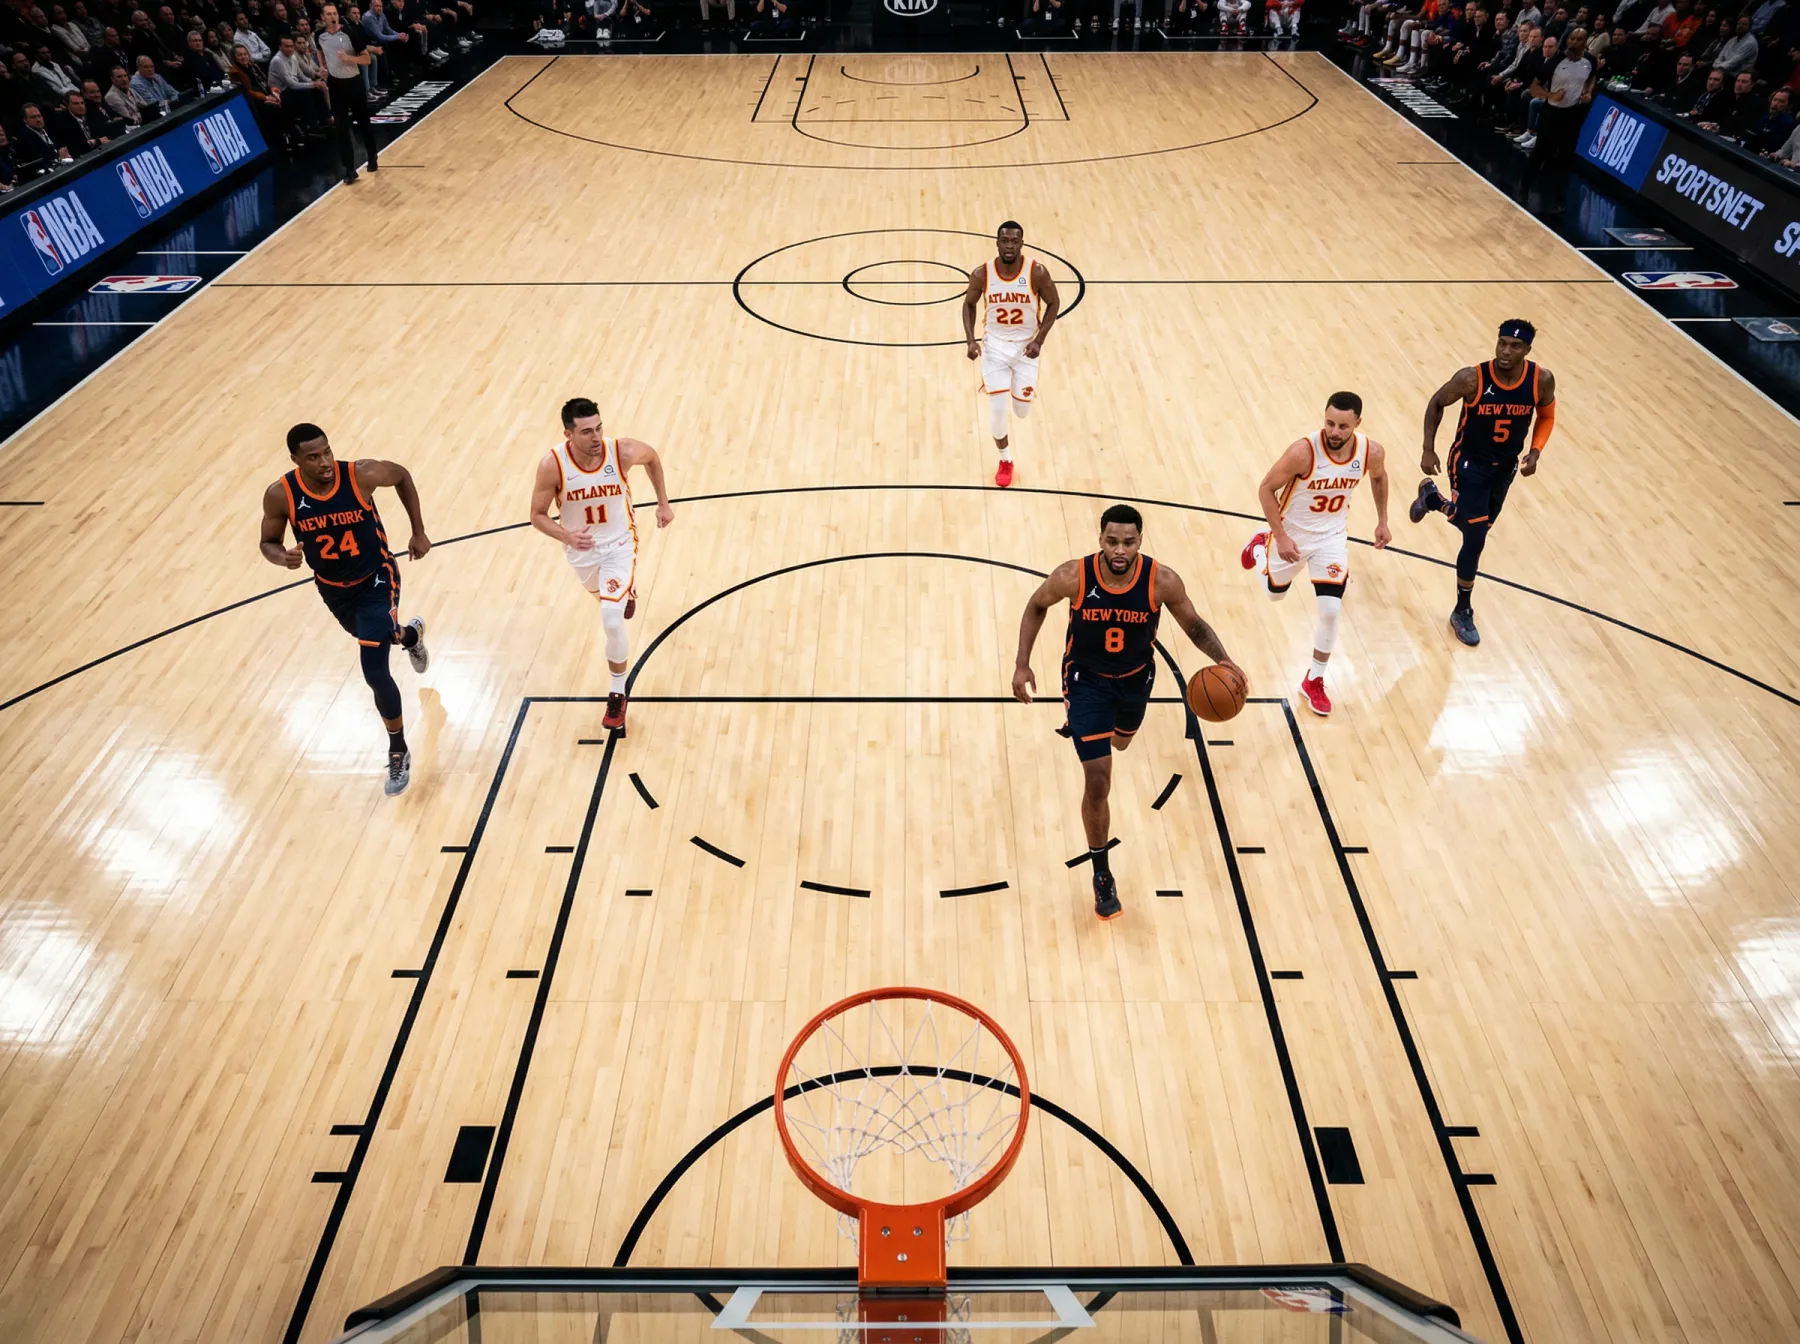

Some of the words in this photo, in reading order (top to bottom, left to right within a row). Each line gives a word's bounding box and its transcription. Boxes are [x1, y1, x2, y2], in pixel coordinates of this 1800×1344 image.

[893, 0, 928, 10] KIA
[205, 108, 251, 166] NBA
[1598, 112, 1646, 175] NBA
[129, 145, 184, 210] NBA
[1656, 153, 1766, 231] SPORTSNET
[38, 190, 105, 265] NBA
[988, 292, 1031, 304] ATLANTA
[996, 307, 1024, 325] 22
[1477, 403, 1504, 416] NEW
[1505, 403, 1532, 416] YORK
[1493, 419, 1512, 443] 5
[566, 484, 622, 502] ATLANTA
[1309, 494, 1346, 513] 30
[297, 514, 327, 533] NEW
[328, 509, 365, 527] YORK
[584, 503, 607, 525] 11
[315, 529, 361, 560] 24
[1082, 608, 1112, 621] NEW
[1114, 608, 1149, 624] YORK
[1104, 627, 1125, 653] 8
